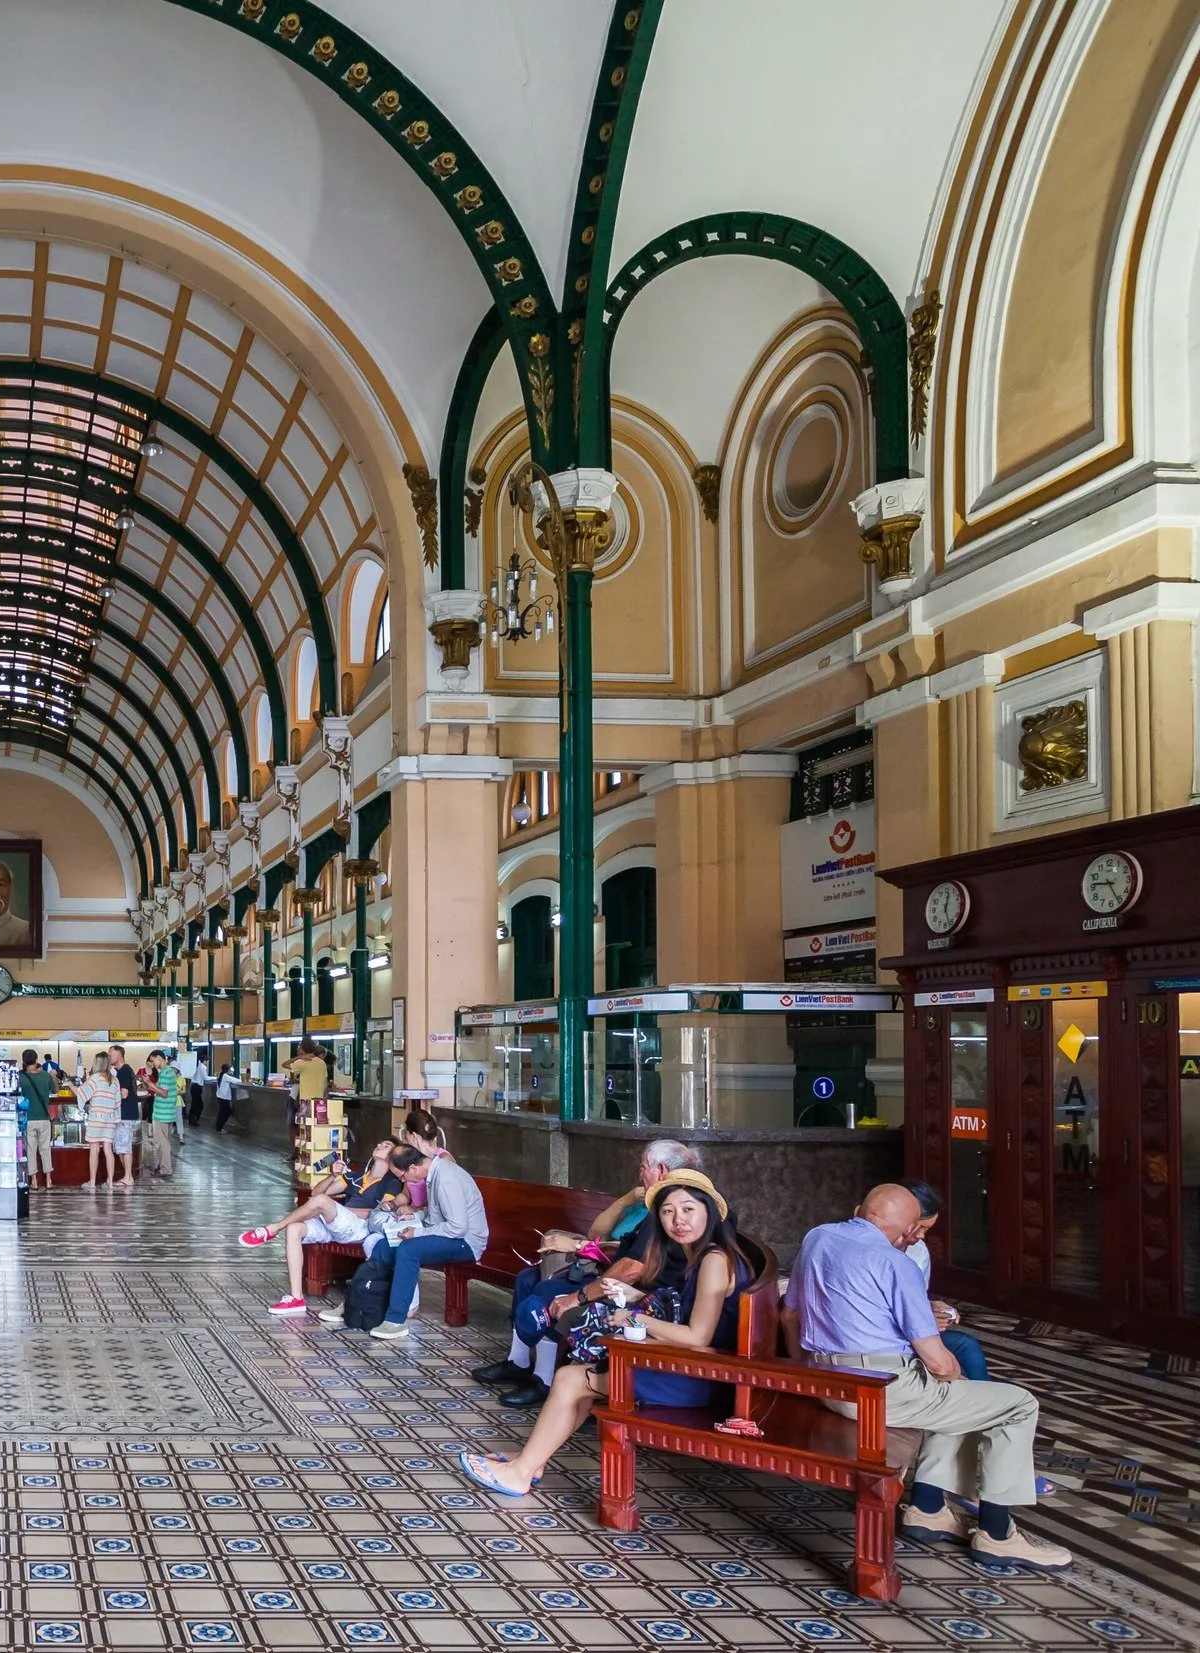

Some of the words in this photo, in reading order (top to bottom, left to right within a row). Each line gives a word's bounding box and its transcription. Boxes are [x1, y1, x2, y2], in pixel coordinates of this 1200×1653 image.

[1100, 899, 1105, 907] 7
[1082, 917, 1117, 930] CALIFORNIA
[795, 994, 854, 1003] LienVietPostBank
[1140, 1001, 1160, 1024] 10
[1182, 1060, 1200, 1074] A
[820, 1082, 826, 1094] 1
[952, 1116, 978, 1131] ATM
[1063, 1076, 1090, 1172] ATM
